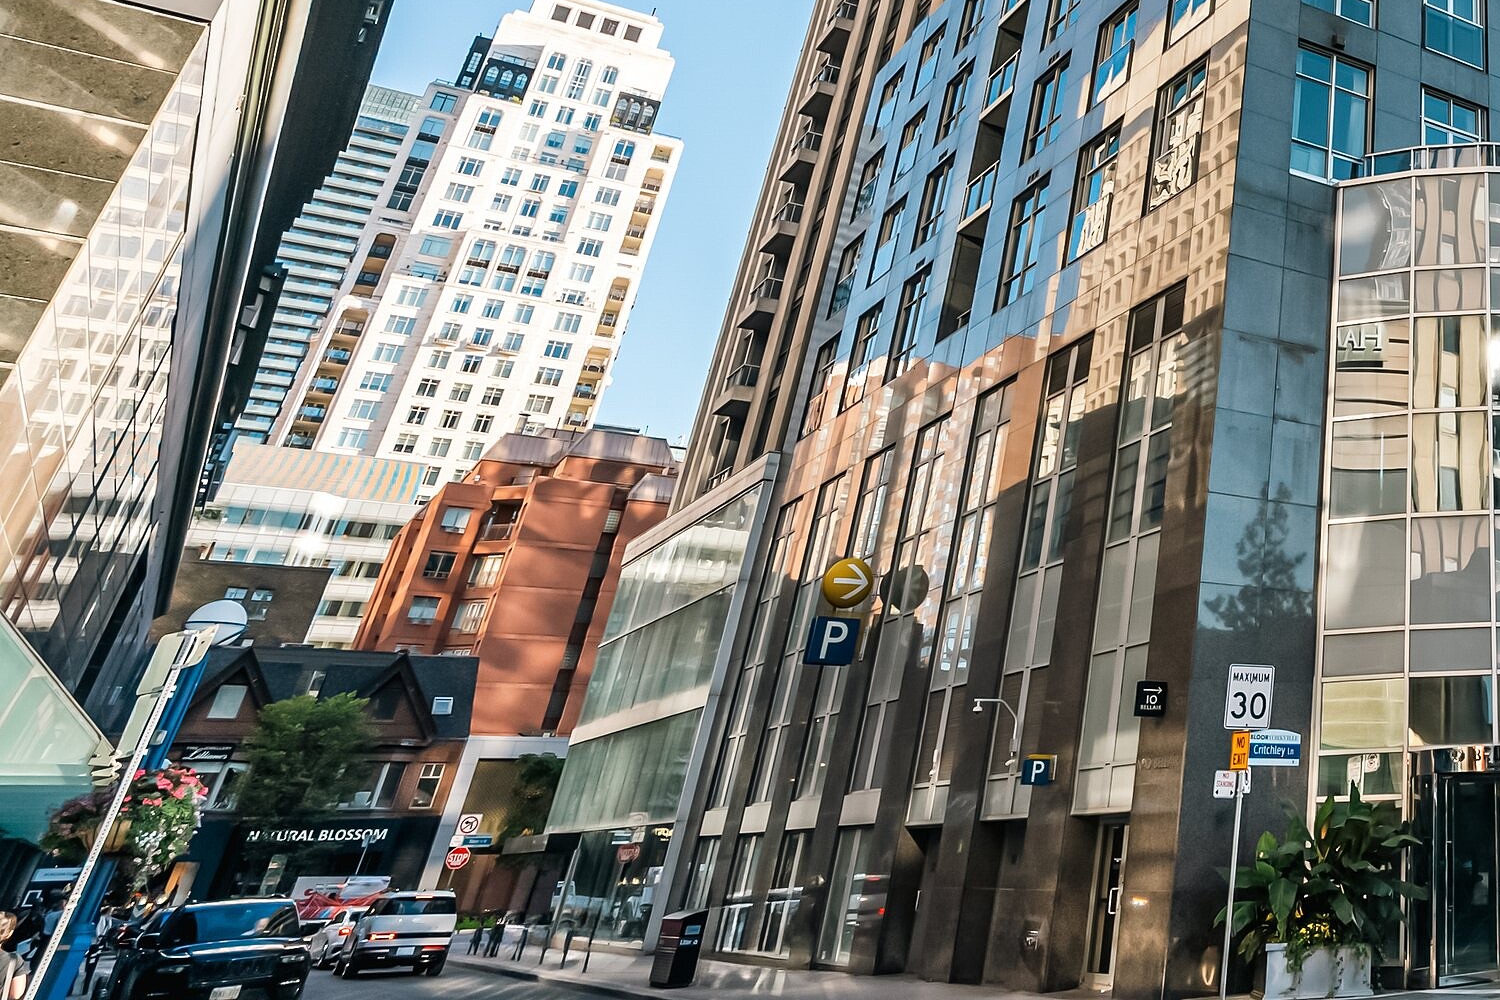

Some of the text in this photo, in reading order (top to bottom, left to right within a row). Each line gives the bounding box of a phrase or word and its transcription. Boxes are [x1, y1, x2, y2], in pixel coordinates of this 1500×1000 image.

[819, 620, 849, 659] P
[1233, 672, 1271, 683] MAXIMUM
[1230, 691, 1267, 720] 30
[1236, 736, 1246, 749] NO
[1253, 744, 1286, 758] Critchley
[1232, 752, 1247, 766] EXIT
[1030, 760, 1045, 783] P
[246, 828, 388, 842] NURAL BLOSSOM
[447, 853, 469, 863] STOP
